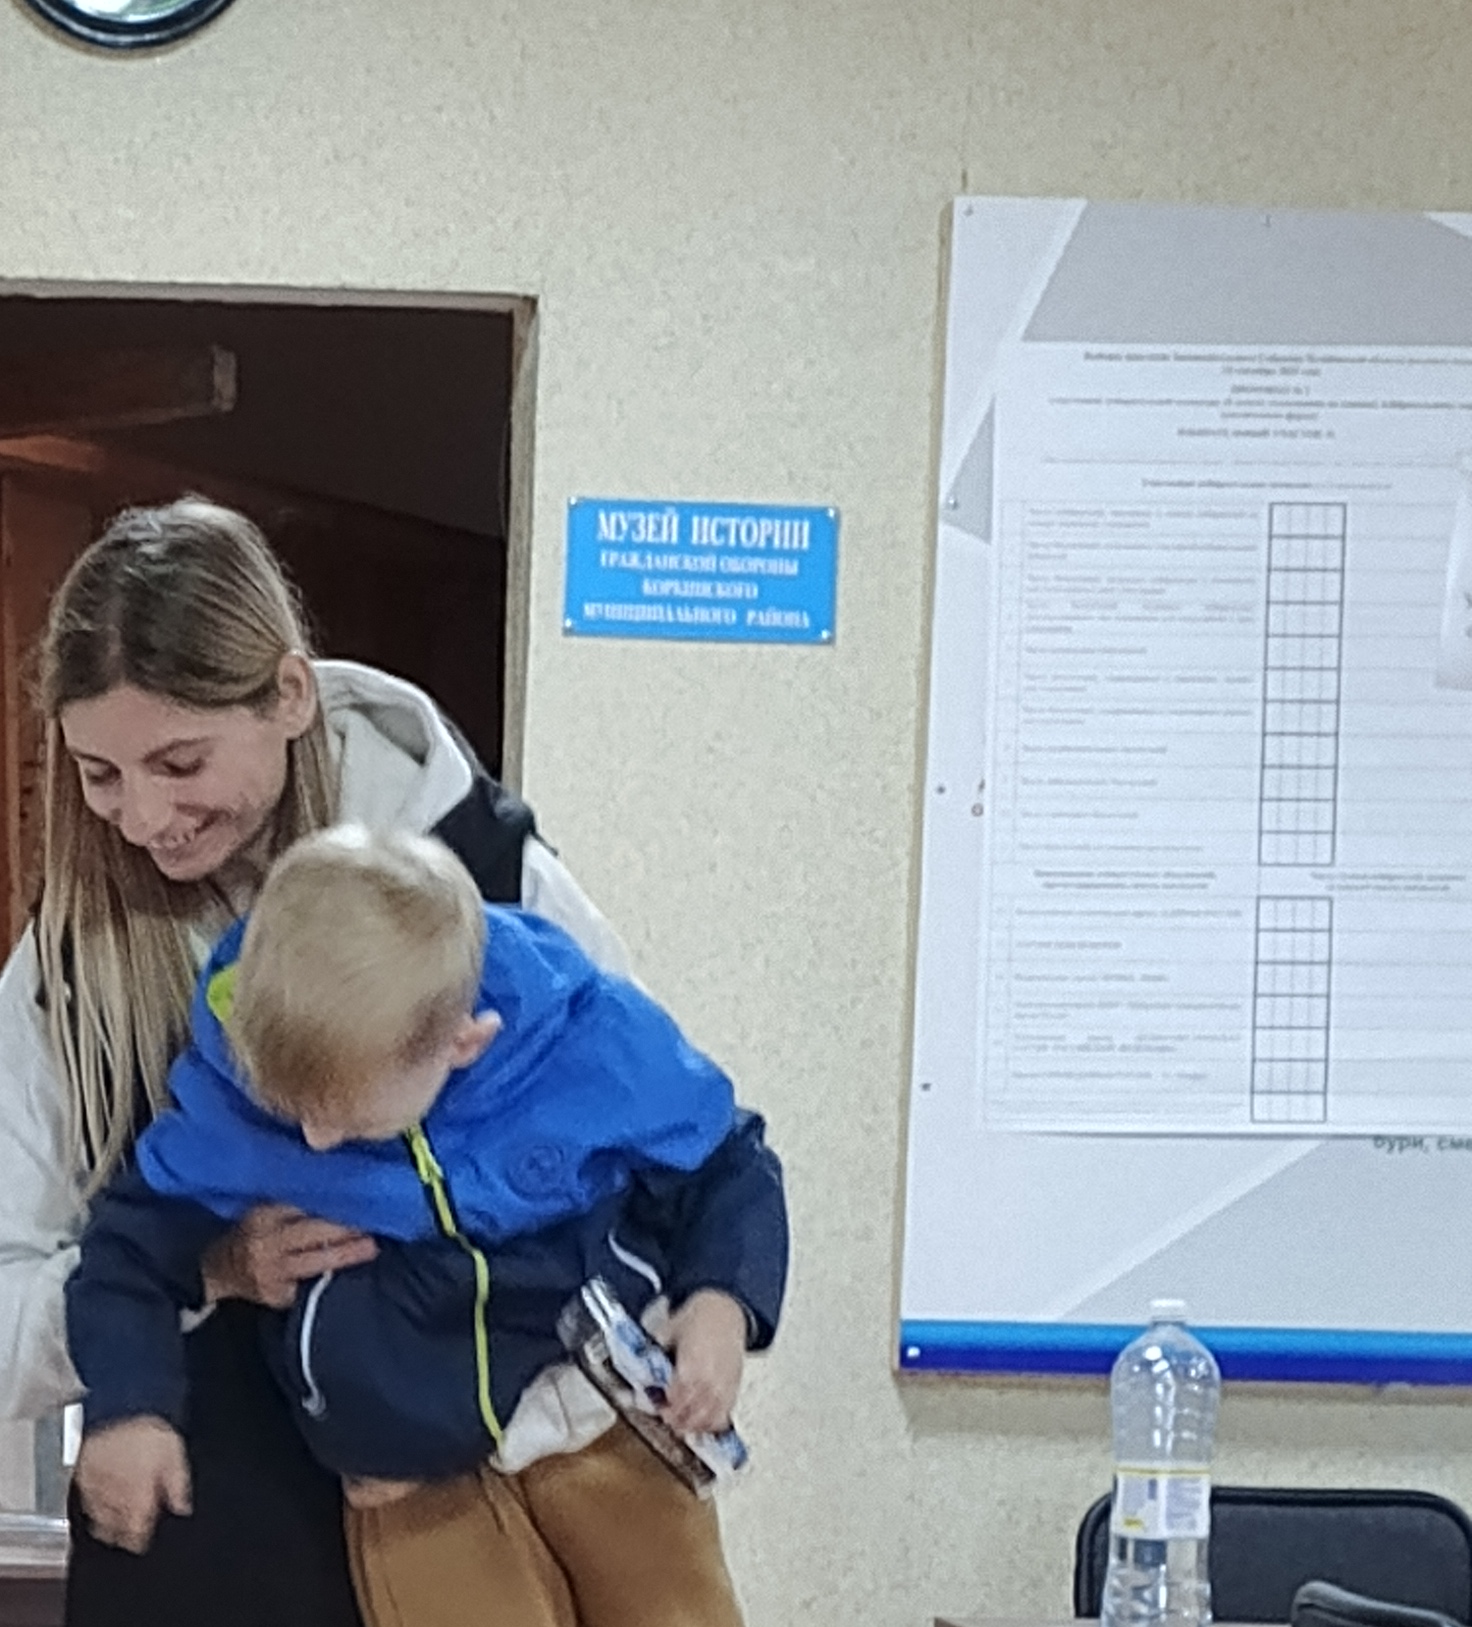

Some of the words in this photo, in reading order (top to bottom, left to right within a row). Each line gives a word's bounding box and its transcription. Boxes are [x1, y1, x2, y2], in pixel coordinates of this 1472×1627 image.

[596, 507, 679, 545] МУЗЕЙ
[691, 515, 810, 550] ИСТОРИИ
[600, 549, 717, 574] ГРАЖДАНСКОЙ
[719, 555, 799, 576] ОБОРОНЫ
[583, 601, 737, 625] МУНИЦИПАЛЬНОГО
[746, 606, 810, 629] РАЙОНА
